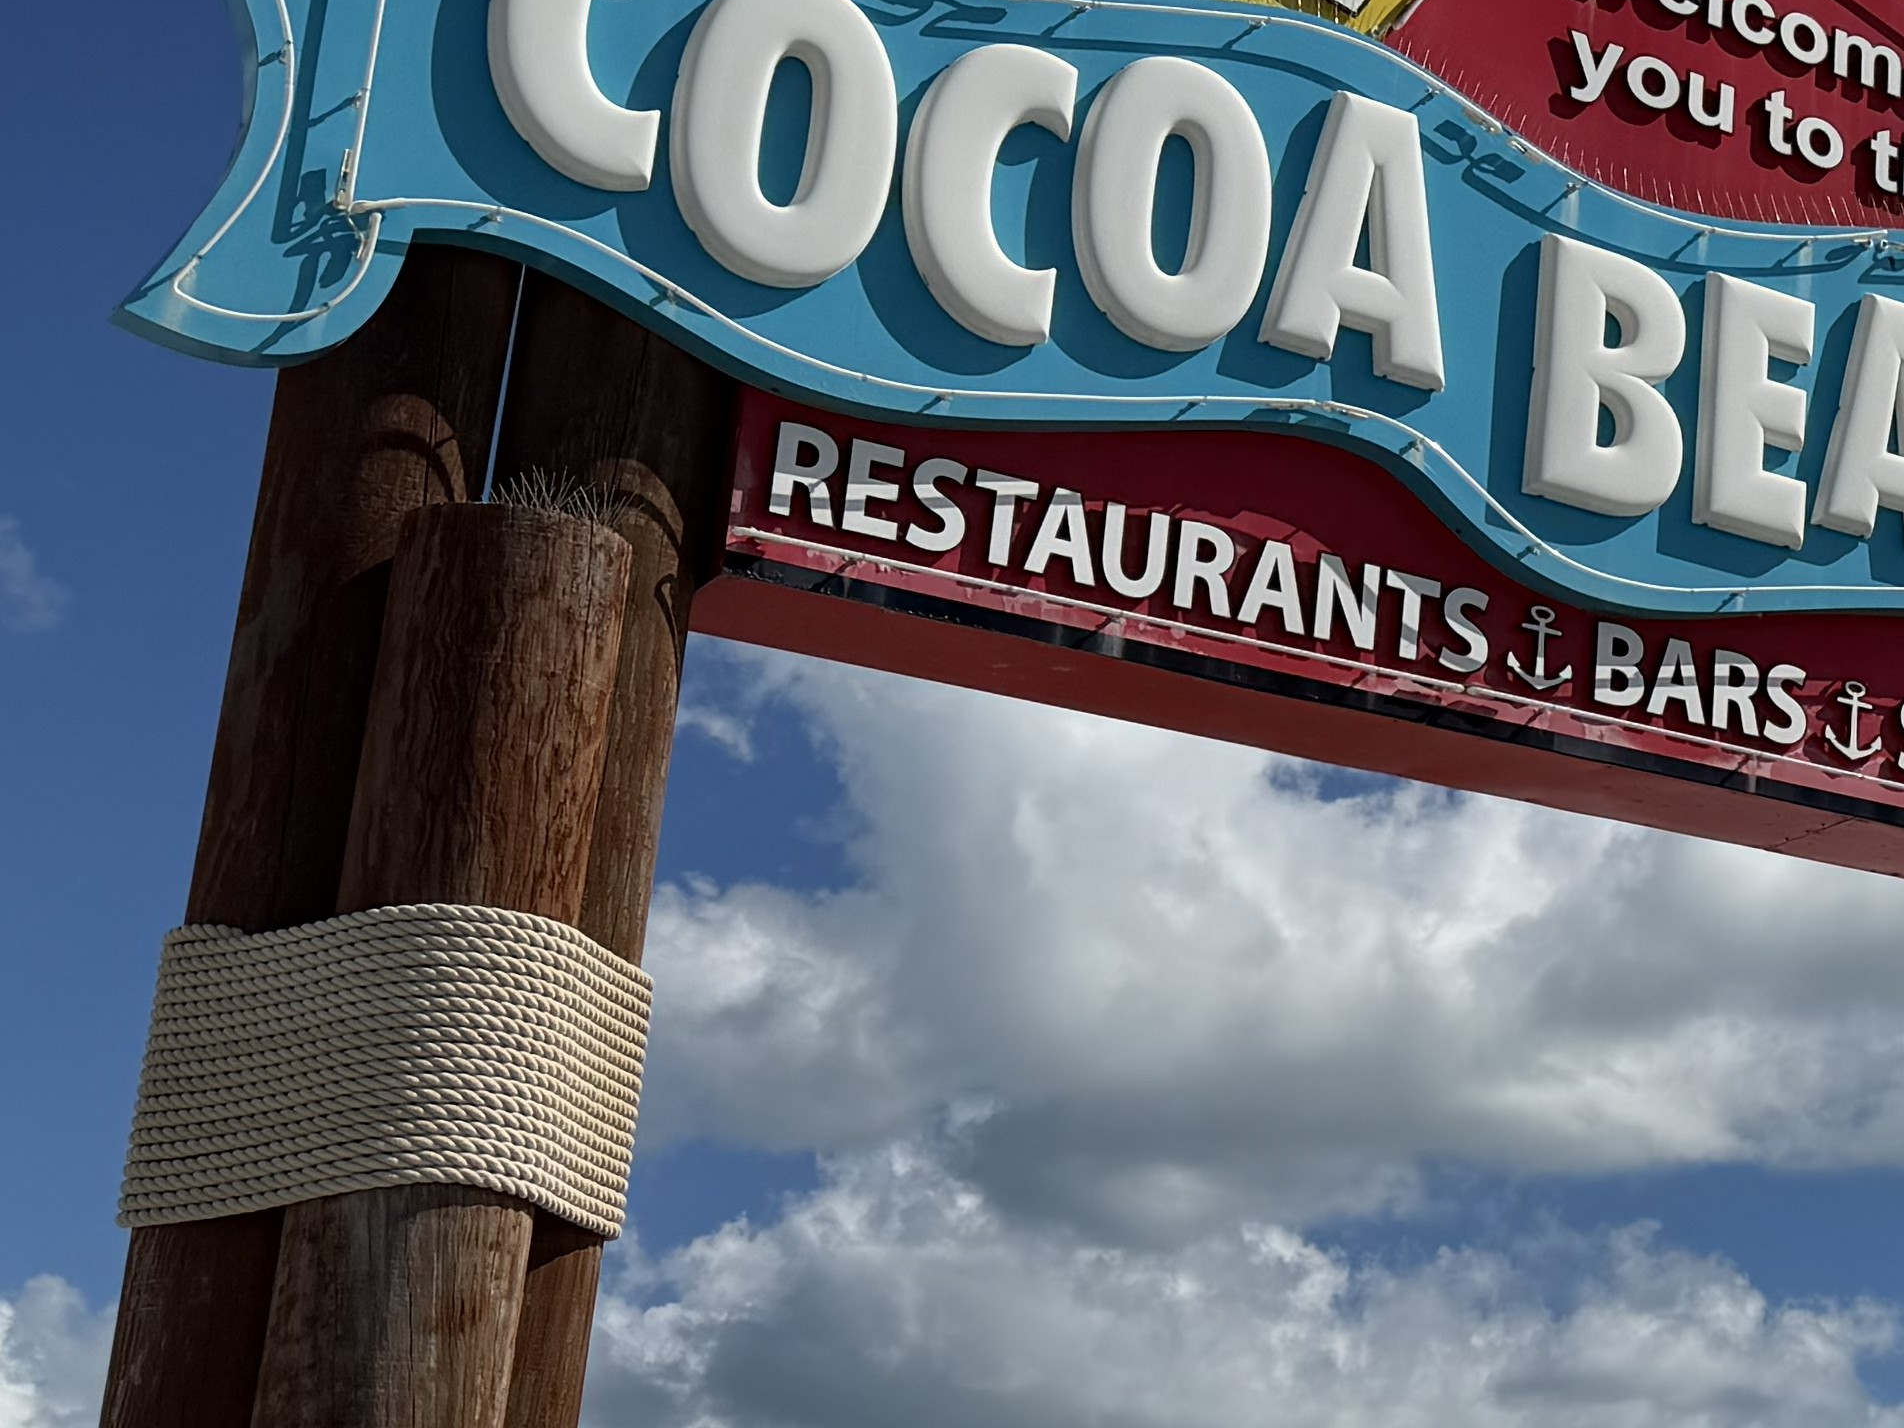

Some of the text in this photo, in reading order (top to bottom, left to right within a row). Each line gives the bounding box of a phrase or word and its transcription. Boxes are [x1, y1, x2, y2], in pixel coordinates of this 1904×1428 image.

[1567, 27, 1737, 133] you
[1762, 89, 1845, 170] to
[767, 421, 1492, 676] RESTAURANTS
[1592, 618, 1807, 746] BARS
